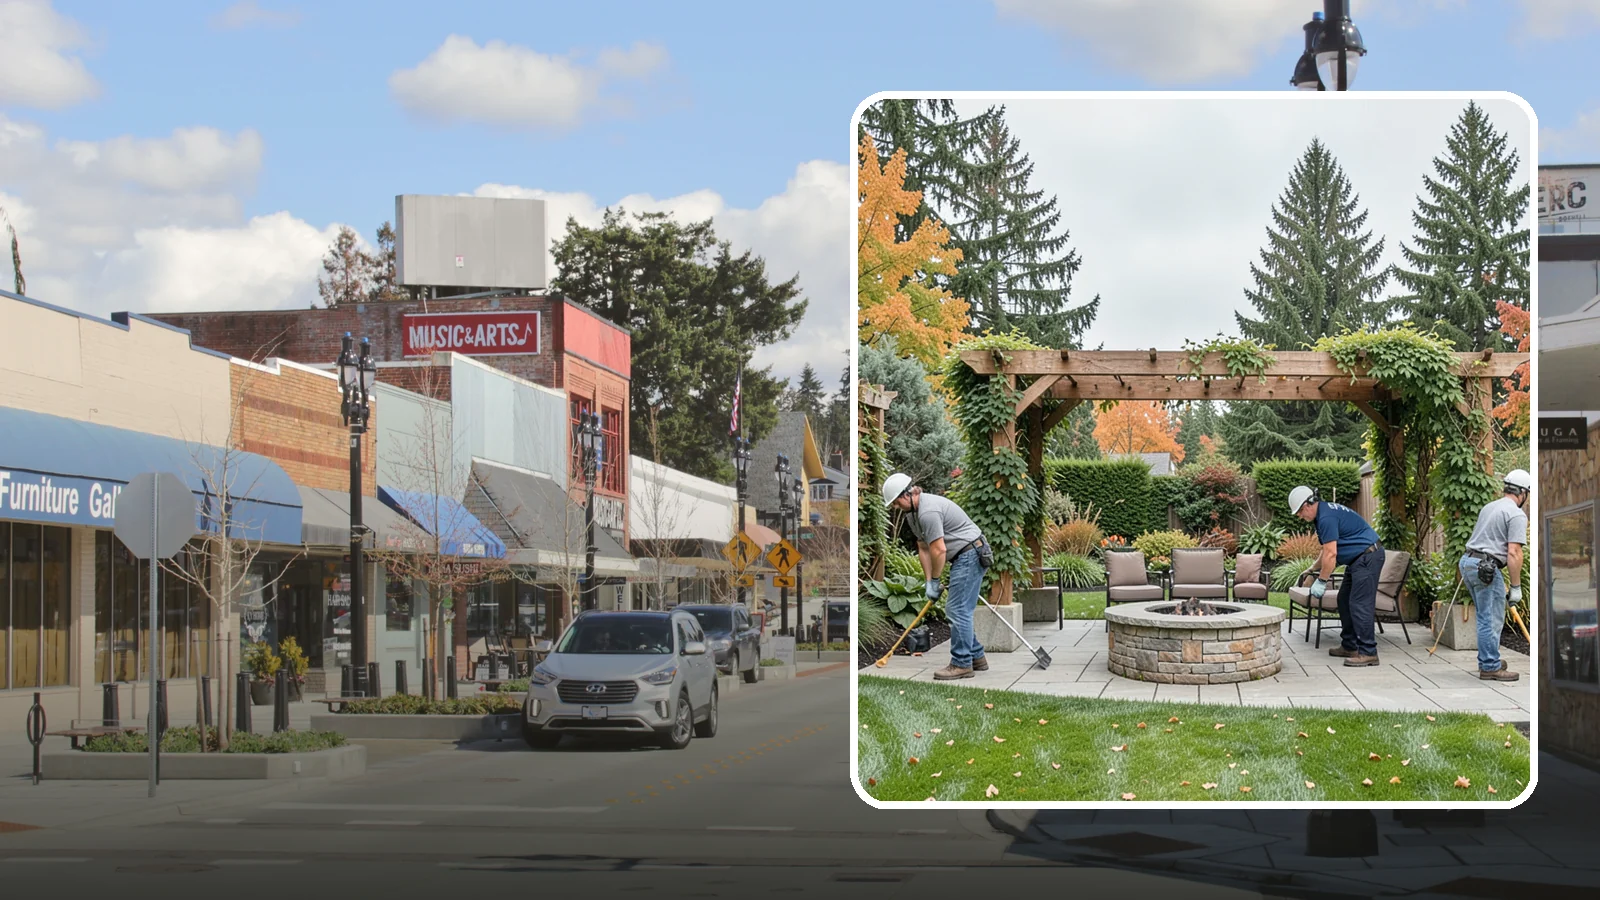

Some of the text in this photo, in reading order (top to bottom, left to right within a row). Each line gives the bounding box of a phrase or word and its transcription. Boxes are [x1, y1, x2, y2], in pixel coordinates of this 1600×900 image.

[1540, 427, 1577, 437] UGA
[0, 471, 122, 519] Furniture Gal
[454, 563, 479, 575] SUSHI
